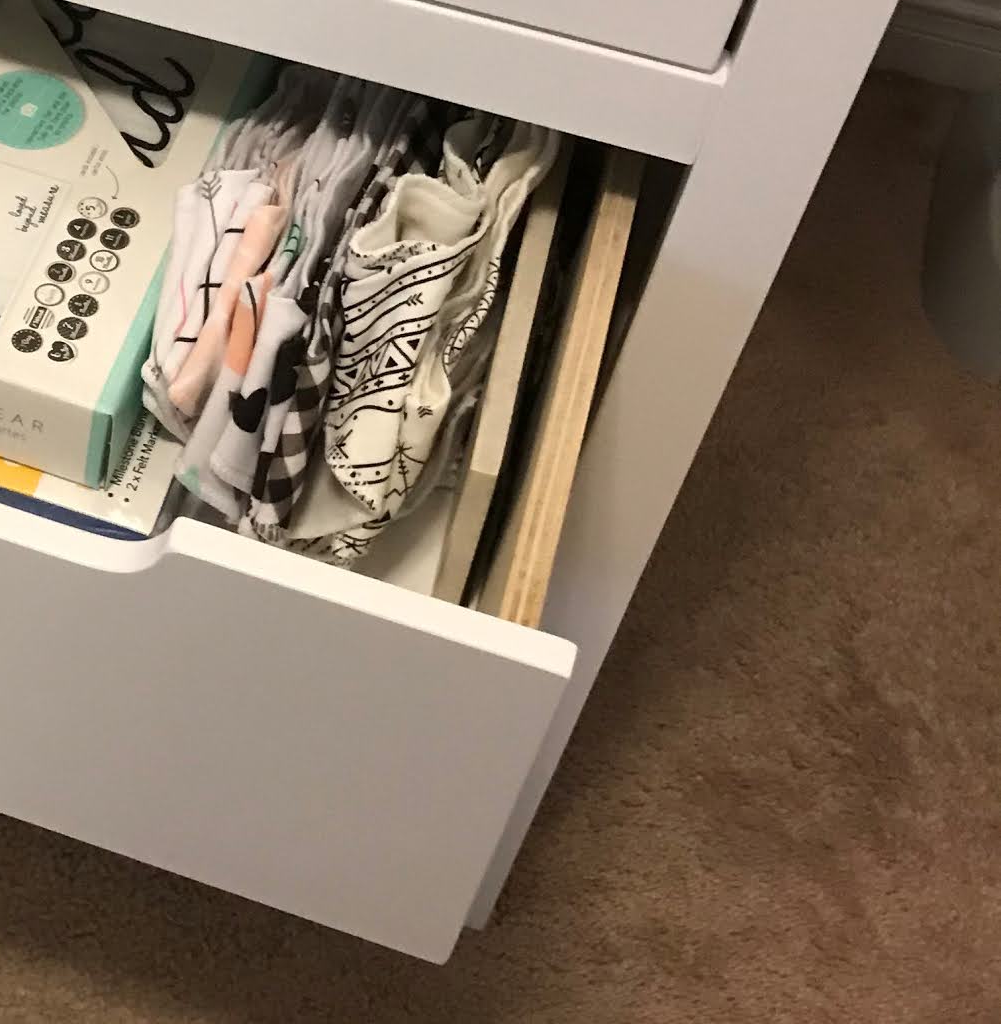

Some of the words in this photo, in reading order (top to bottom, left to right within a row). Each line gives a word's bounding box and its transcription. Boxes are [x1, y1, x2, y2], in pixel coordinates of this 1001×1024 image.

[109, 437, 140, 487] Milestone
[125, 481, 139, 492] 2
[132, 453, 150, 476] Felt
